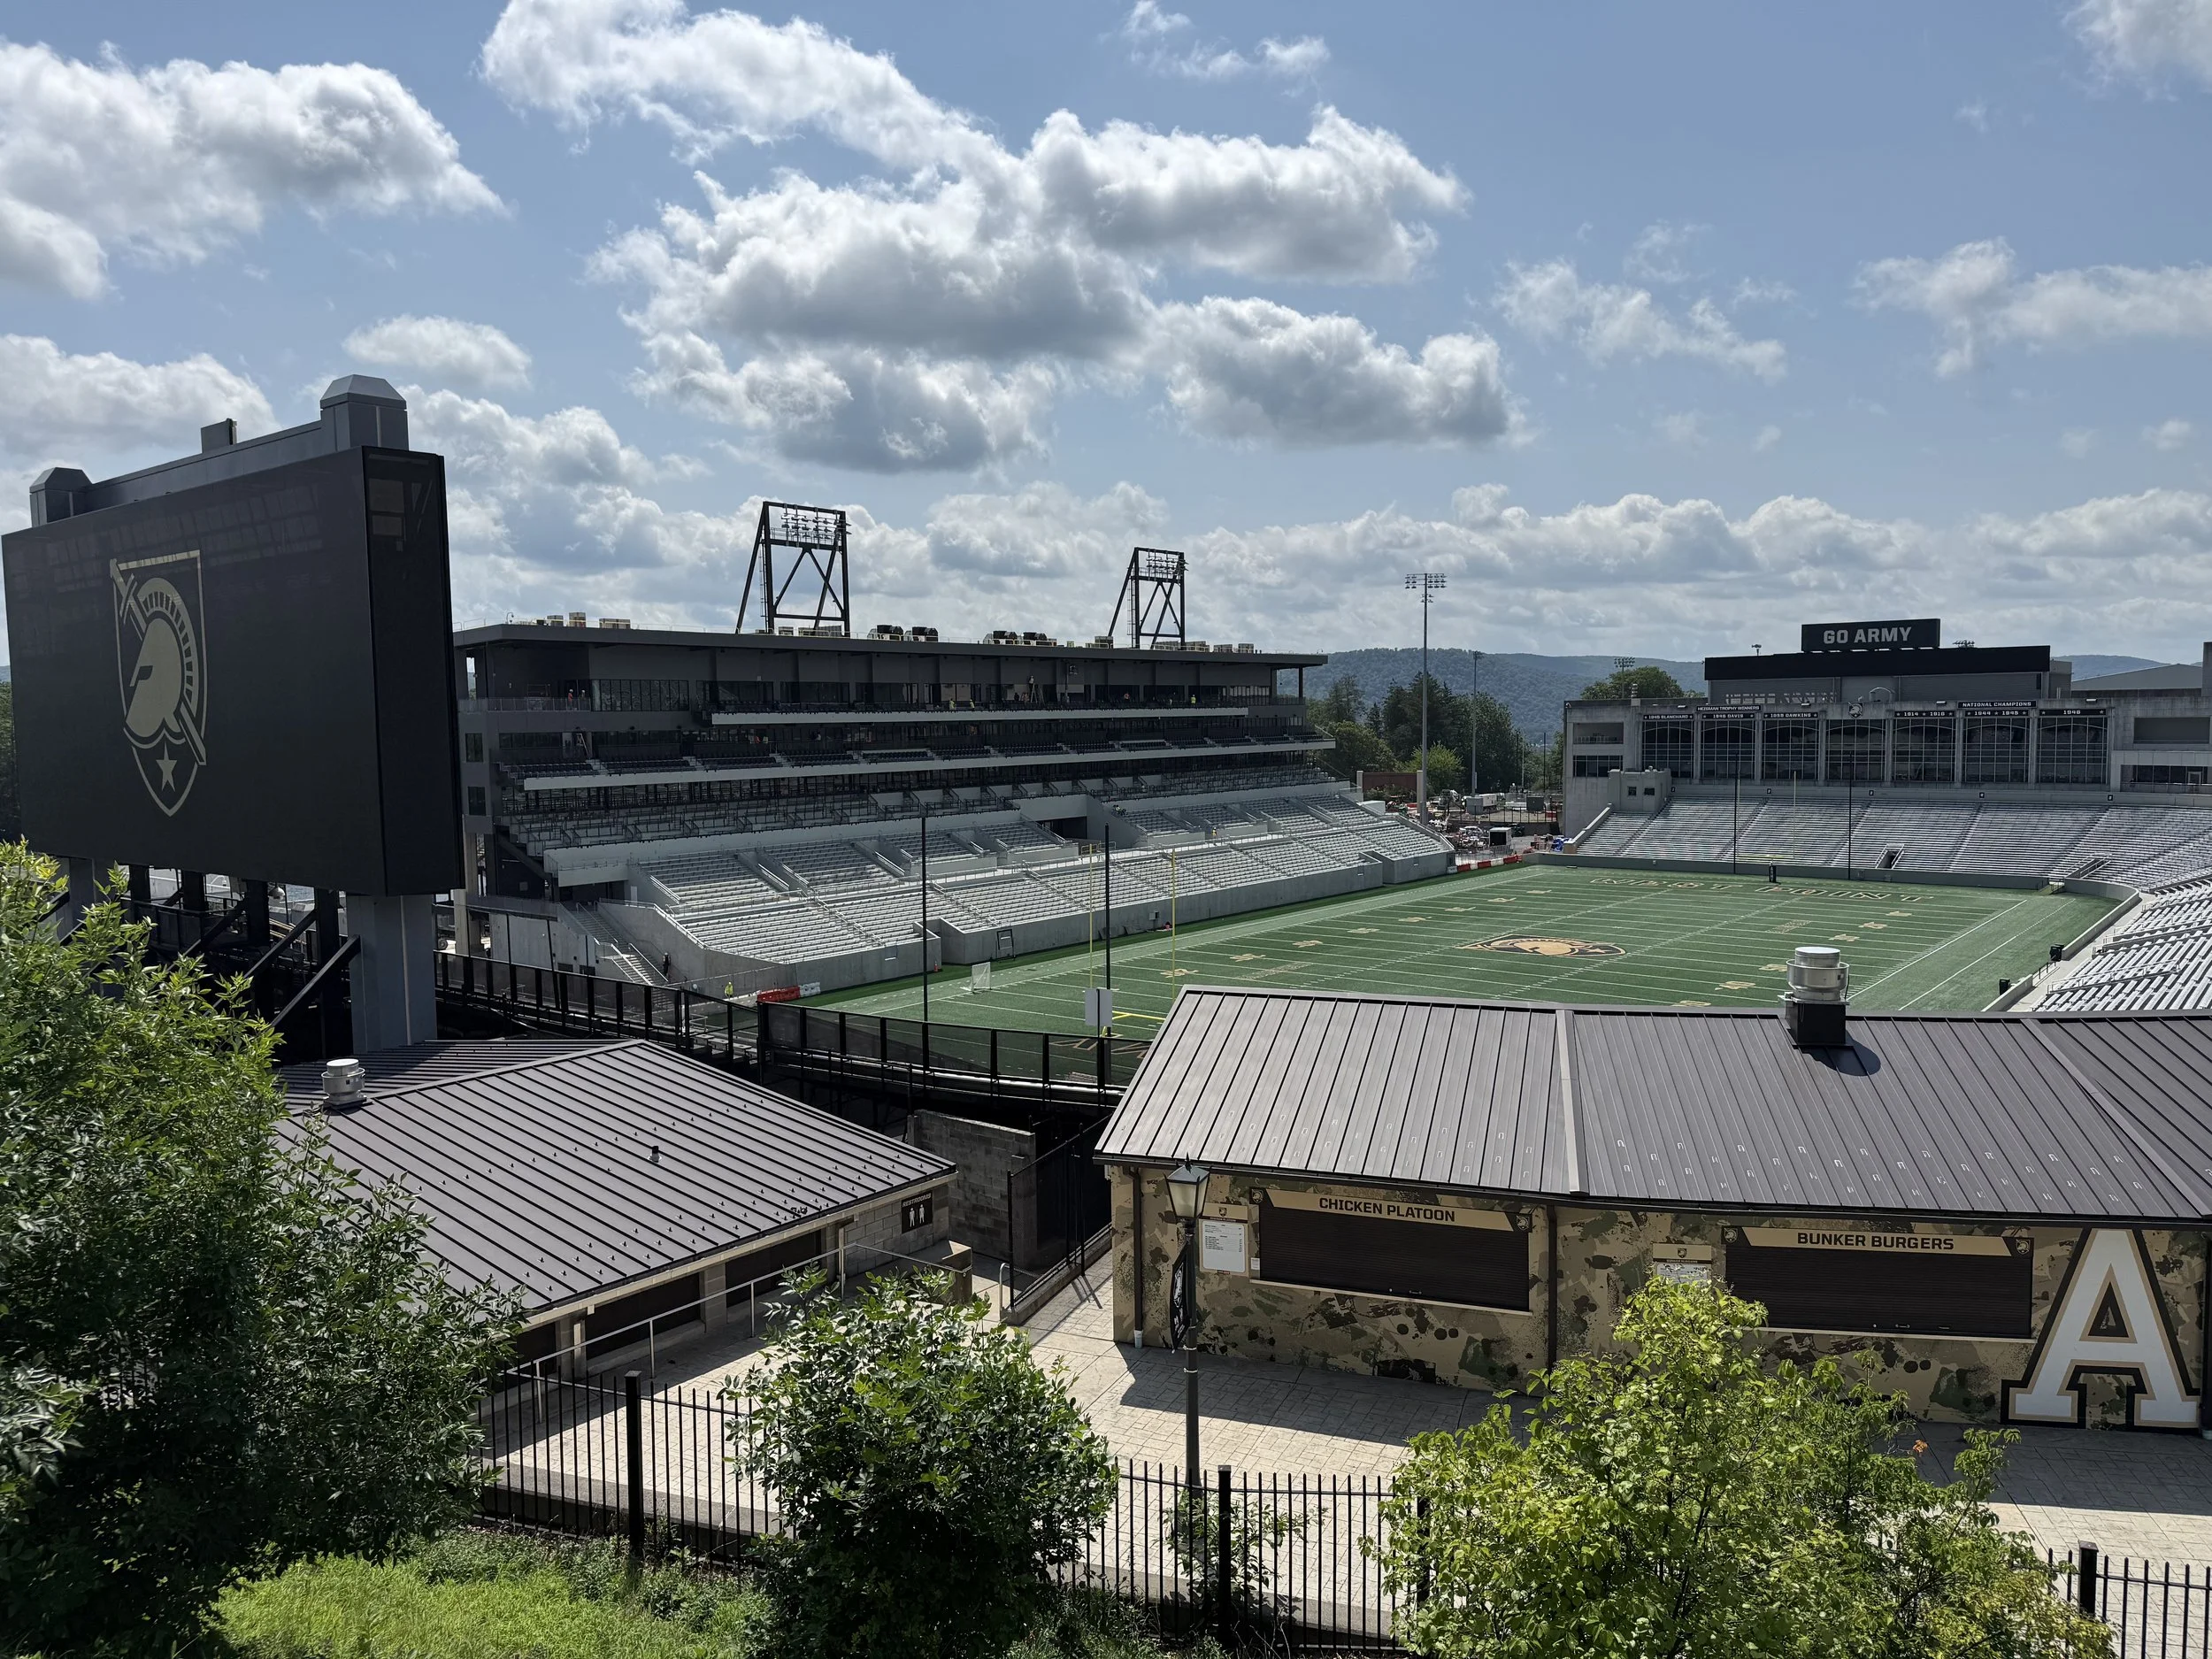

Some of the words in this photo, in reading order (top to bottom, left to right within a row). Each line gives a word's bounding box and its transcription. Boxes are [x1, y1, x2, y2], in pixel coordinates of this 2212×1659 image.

[1823, 629, 1848, 644] GO
[1854, 626, 1912, 643] ARMY
[1755, 886, 1935, 902] POINT
[902, 1193, 932, 1207] RESTROOMS
[1319, 1197, 1382, 1215] CHICKEN
[1386, 1204, 1455, 1222] PLATOON
[1797, 1232, 1866, 1247] BUNKER
[1871, 1235, 1955, 1250] BURGERS
[2001, 1226, 2201, 1432] A
